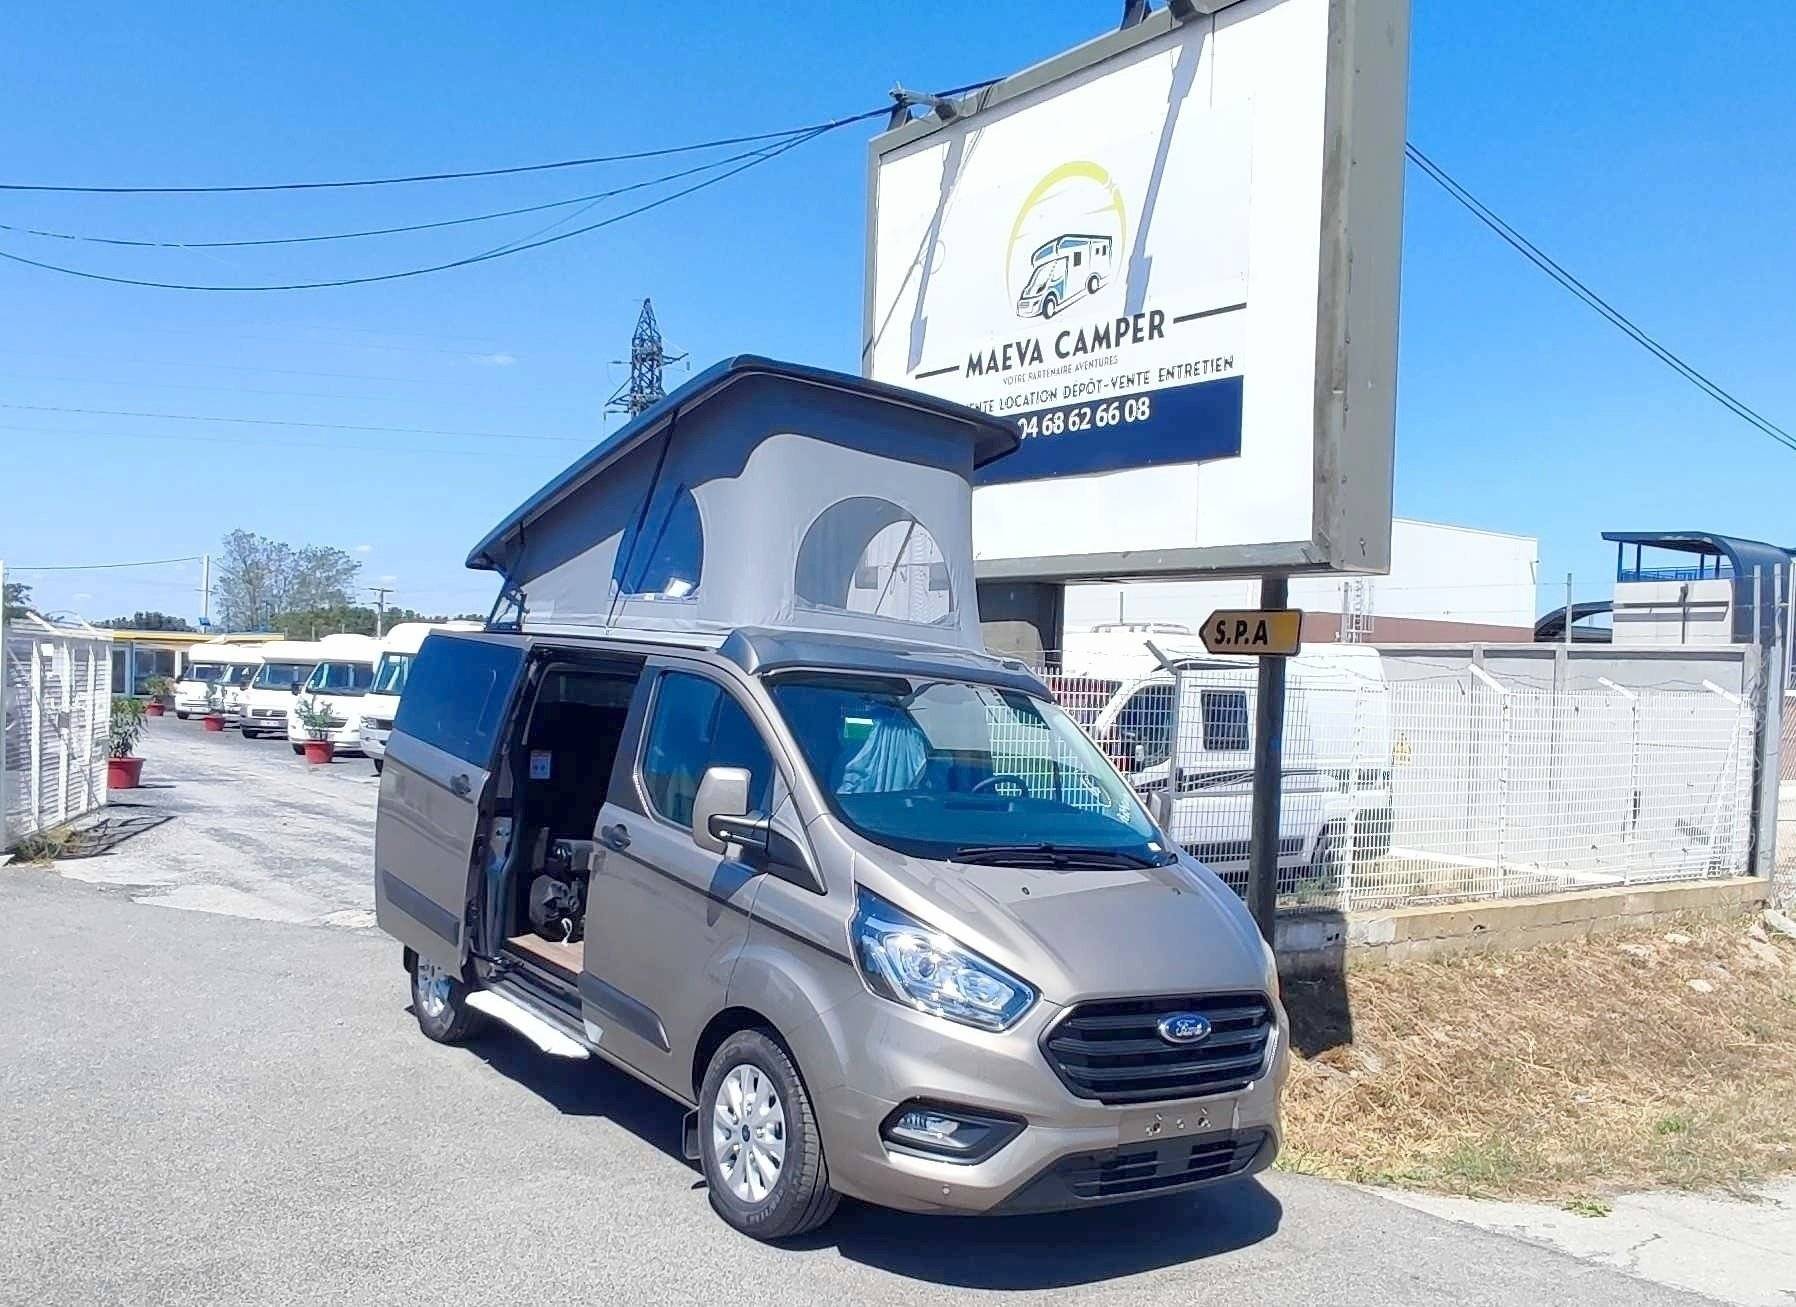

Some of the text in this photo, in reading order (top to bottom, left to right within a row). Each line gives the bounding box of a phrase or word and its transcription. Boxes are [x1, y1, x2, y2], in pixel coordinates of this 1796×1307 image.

[966, 310, 1164, 378] MAEVA CAMPER
[1075, 355, 1118, 372] AVENTURES
[1000, 387, 1057, 411] LOCATION
[1158, 355, 1234, 382] ENTRETIEN
[1042, 412, 1065, 436] 68
[1068, 407, 1092, 432] 62
[1095, 401, 1120, 427] 66
[1124, 396, 1150, 423] 08
[1175, 1019, 1203, 1037] Ford
